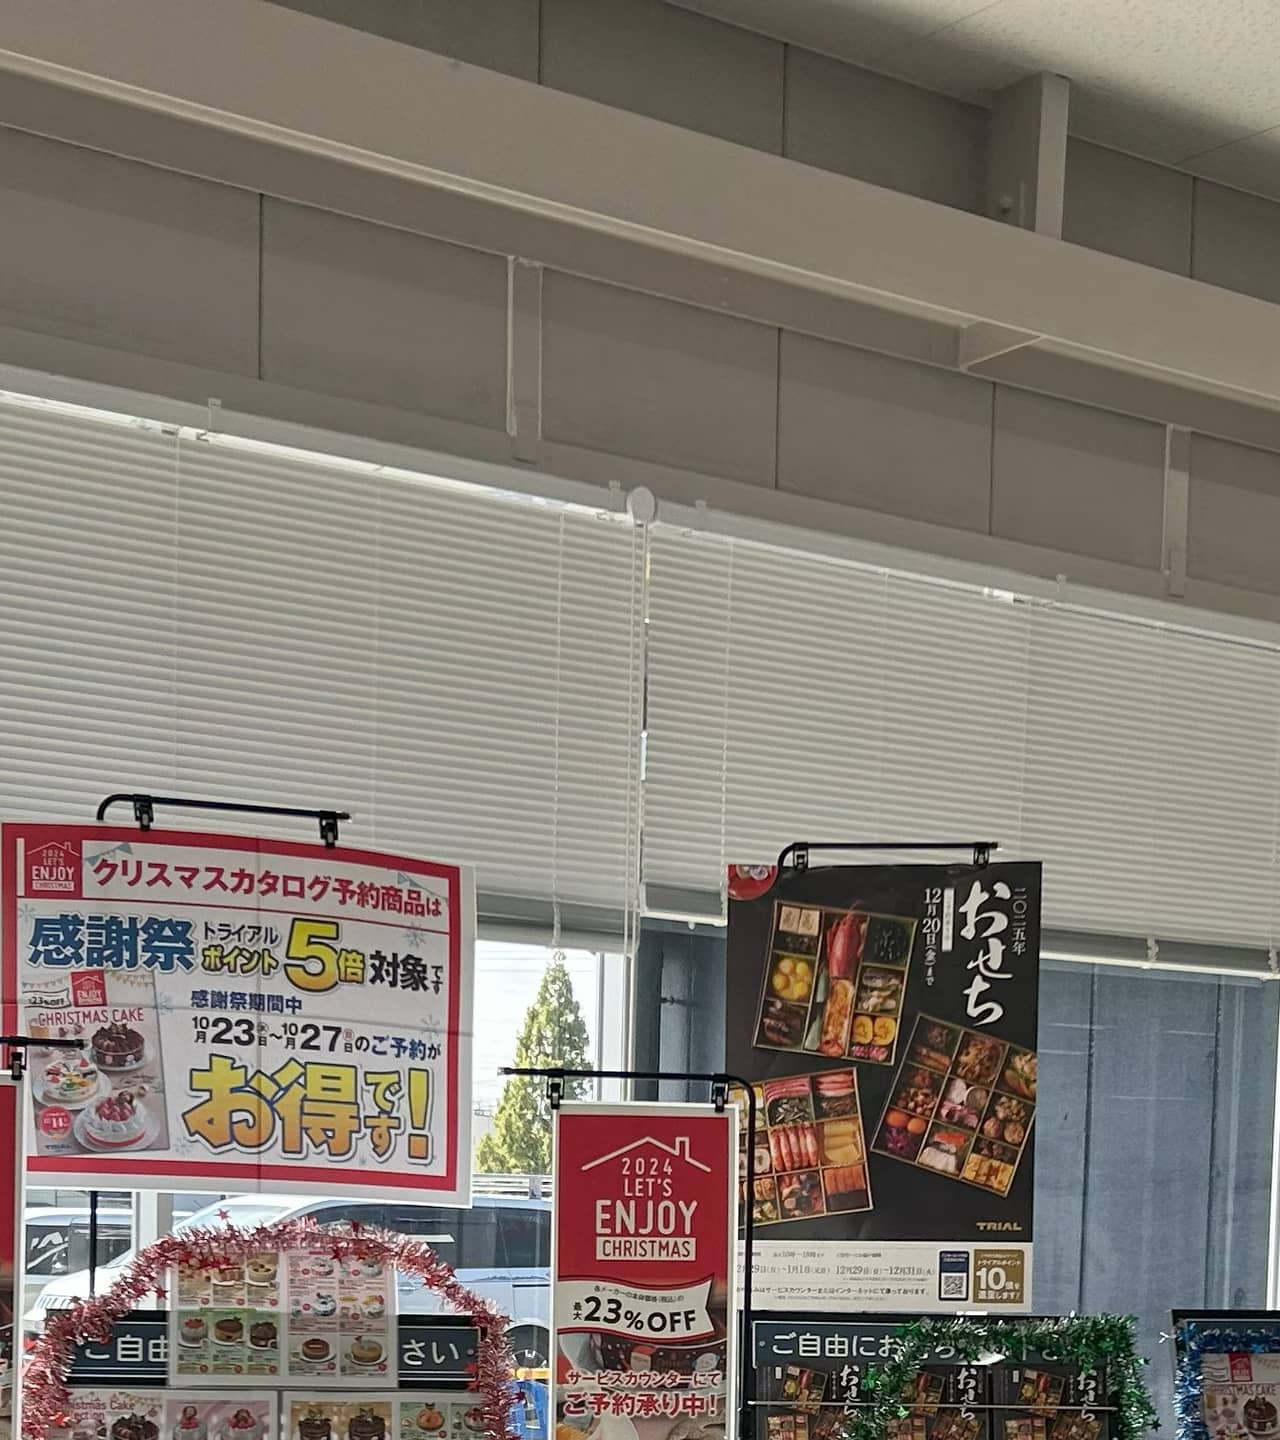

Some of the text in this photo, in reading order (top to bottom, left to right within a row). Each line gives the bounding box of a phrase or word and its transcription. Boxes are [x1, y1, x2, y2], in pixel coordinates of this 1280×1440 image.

[32, 866, 75, 880] ENJOY
[93, 859, 442, 918] クリスマスカタログ予約商品は
[27, 914, 195, 971] 感謝祭
[958, 880, 1014, 1026] おせち
[191, 990, 302, 1014] 感謝祭期間中
[38, 1008, 144, 1026] CHRISTMAS CAKE
[621, 1157, 673, 1176] 2024
[623, 1178, 673, 1197] LET'S
[595, 1199, 698, 1235] ENJOY
[975, 1221, 1023, 1232] TRIAL
[602, 1240, 690, 1258] CHRISTMAS
[567, 1371, 721, 1387] サービスカウンターにて
